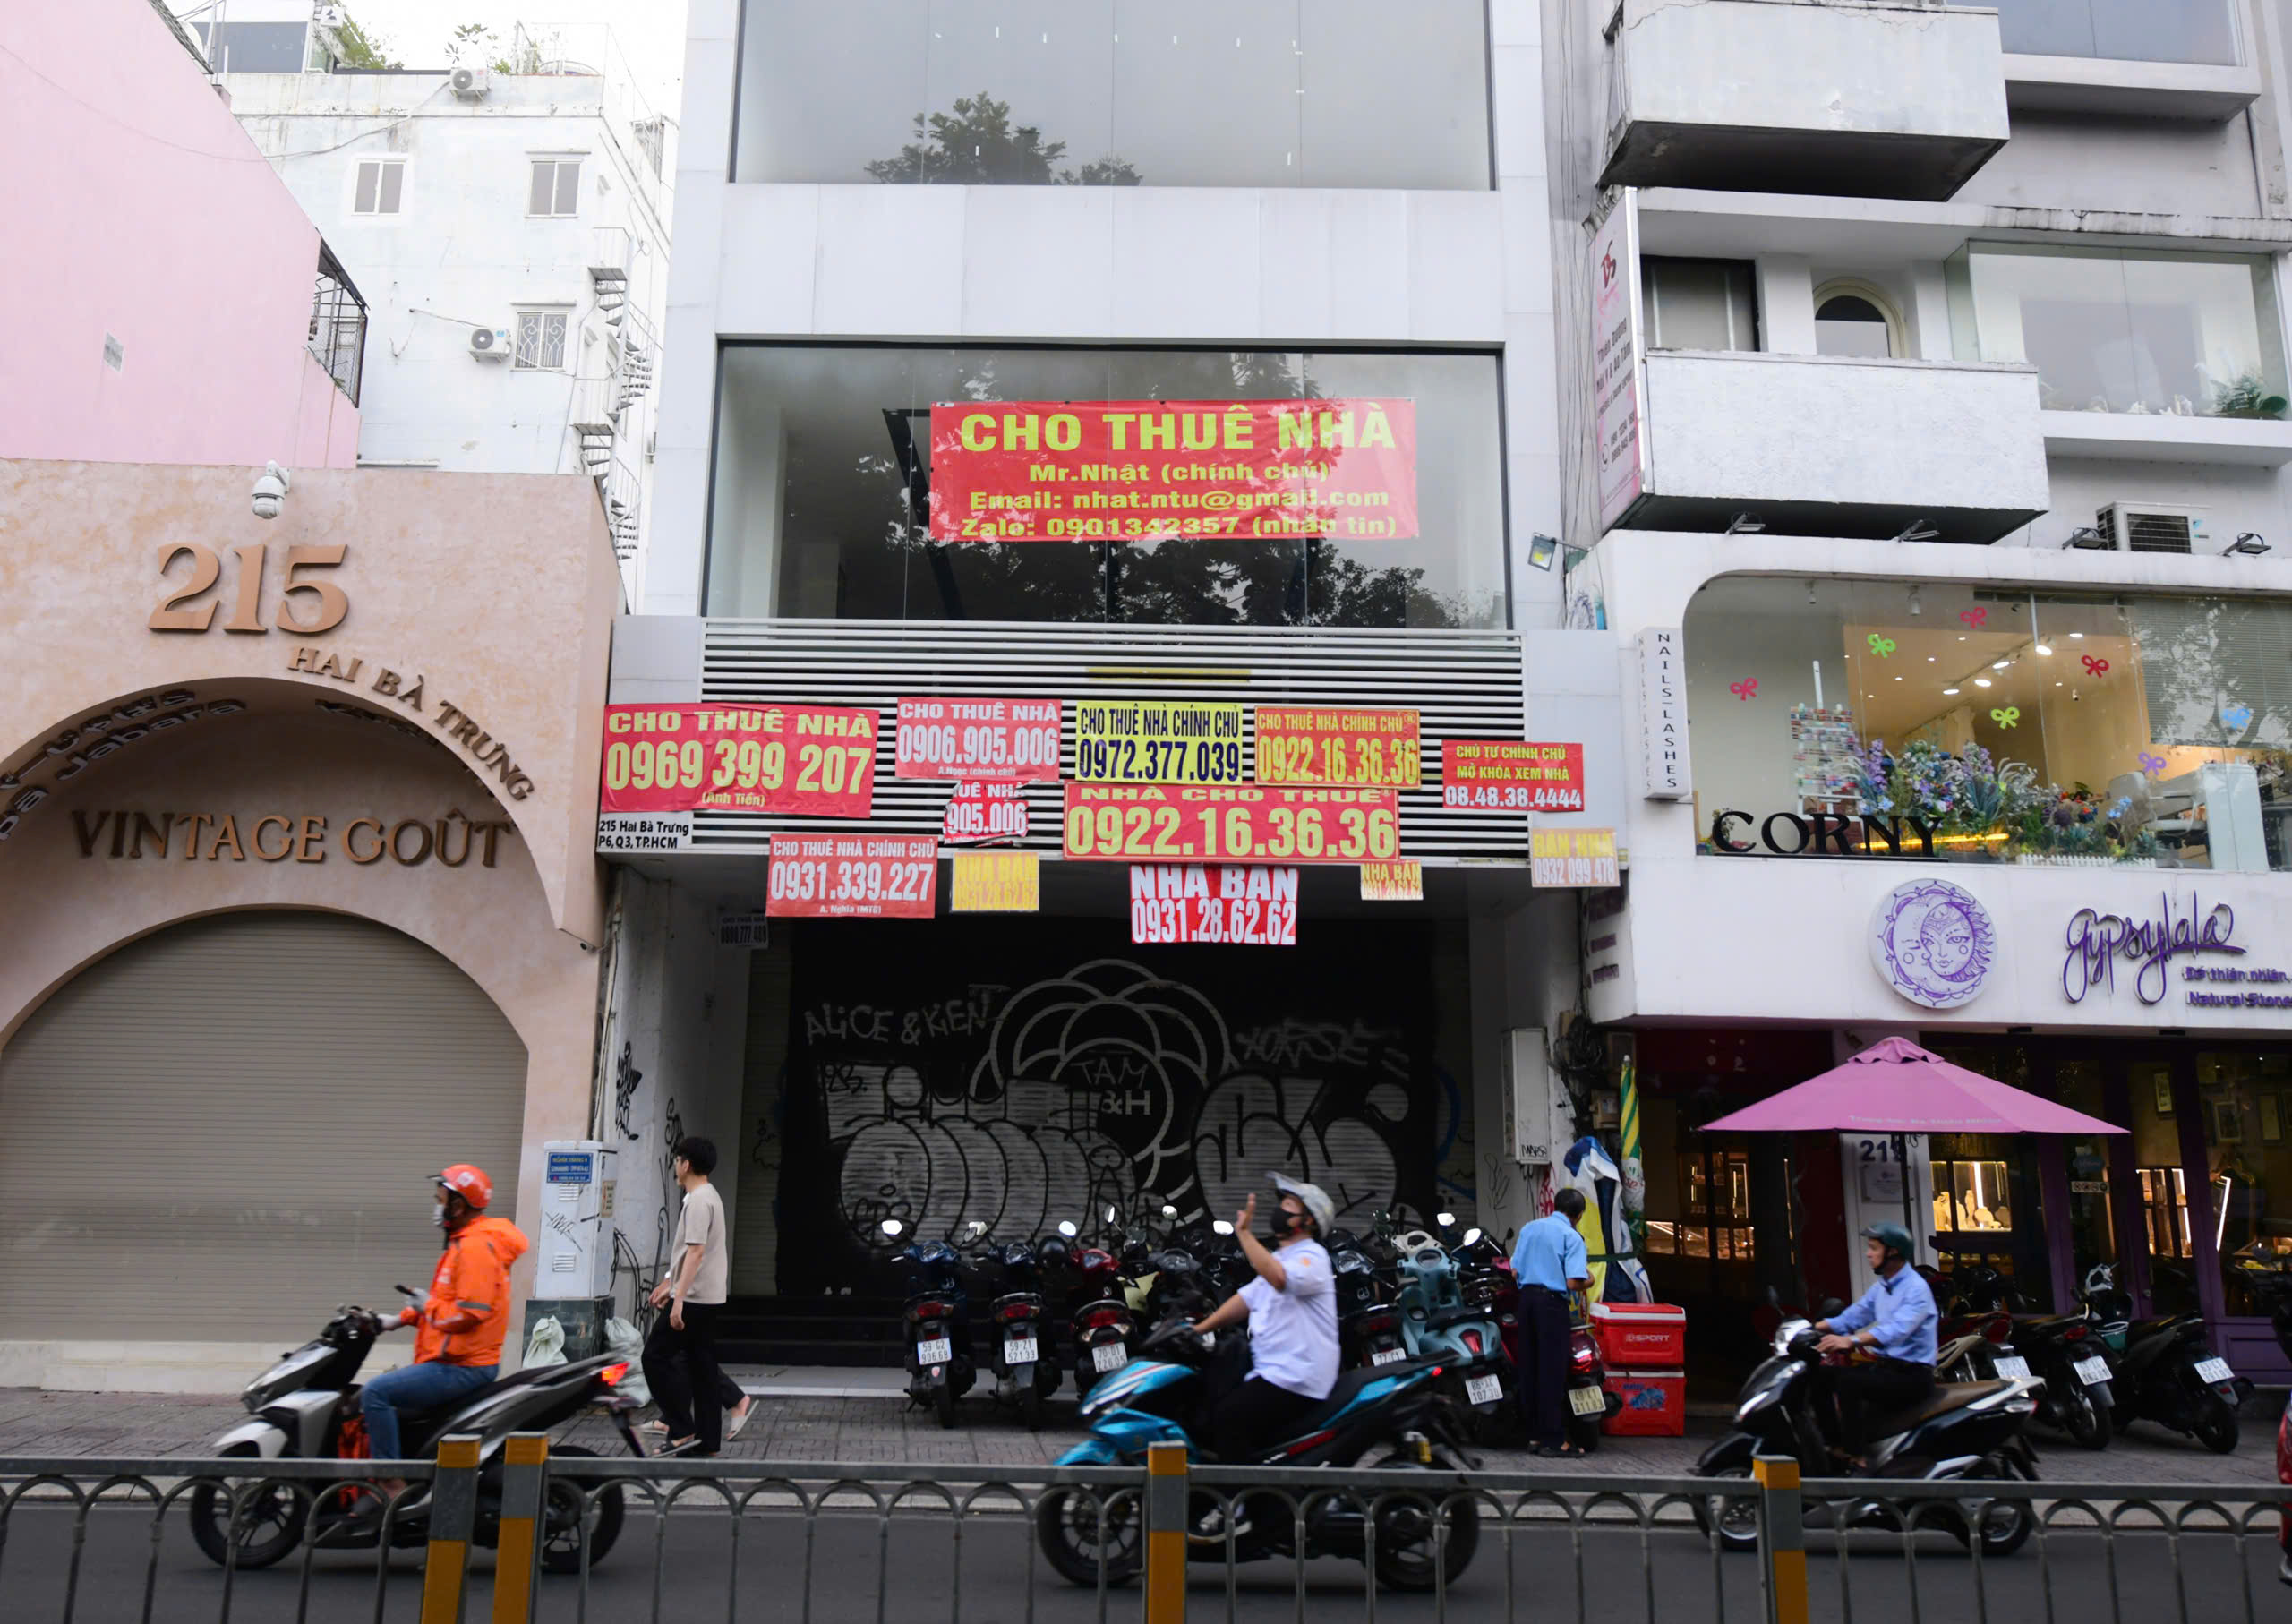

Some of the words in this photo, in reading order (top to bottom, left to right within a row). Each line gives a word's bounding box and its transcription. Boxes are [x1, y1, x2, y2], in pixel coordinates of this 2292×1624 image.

[961, 414, 1082, 451] CHO
[1103, 404, 1254, 450] THUÊ
[1279, 402, 1396, 449] NHÀ
[1030, 464, 1150, 484] Mr.Nhật
[1161, 462, 1253, 484] (chính
[1264, 460, 1329, 483] chủ)
[971, 492, 1062, 509] Email:
[1073, 489, 1389, 511] nhat.ntu@gmail.com
[961, 518, 1035, 537] Zalo:
[1047, 517, 1239, 536] 0901342357
[1253, 512, 1337, 535] (nhắn
[1347, 516, 1397, 535] tin)
[148, 543, 349, 635] 215
[286, 647, 363, 683] HAI
[372, 668, 425, 712] BÀ
[433, 699, 535, 801] TRƯNG
[608, 711, 682, 733] CHO
[694, 709, 784, 733] THUÊ
[796, 713, 873, 739] NHÀ
[900, 703, 944, 718] CHO
[951, 702, 1005, 721] THUÊ
[1013, 703, 1058, 722] NHÀ
[1081, 706, 1105, 735] CHO
[1109, 704, 1138, 736] THUÊ
[1143, 704, 1168, 737] NHÀ
[1173, 705, 1210, 737] CHÍNH
[1215, 705, 1239, 739] CHỦ
[1258, 713, 1280, 731] CHO
[1285, 712, 1313, 731] THUÊ
[1316, 711, 1339, 731] NHÀ
[1342, 712, 1376, 732] CHÍNH
[1380, 712, 1403, 733] CHỦ
[898, 724, 1058, 766] 0906.905.006
[1502, 745, 1538, 760] CHÍNH
[606, 740, 703, 790] 0969
[712, 739, 786, 788] 399
[796, 744, 872, 794] 207
[1079, 739, 1239, 781] 0972.377.039
[1258, 735, 1418, 785] 0922.16.36.36
[1515, 766, 1541, 780] XEM
[954, 782, 981, 798] UÊ
[1081, 786, 1167, 801] NHÀ
[1182, 789, 1264, 802] CHO
[1279, 789, 1380, 804] THUÊ
[1445, 786, 1582, 809] 08.48.38.4444
[71, 809, 328, 865] VINTAGE
[340, 808, 518, 868] GOÛT
[599, 820, 617, 833] 215
[620, 820, 637, 833] Hai
[640, 820, 653, 833] Bà
[656, 821, 688, 836] Trưng
[1068, 806, 1397, 857] 0922.16.36.36
[1712, 811, 1944, 857] CORNY
[774, 841, 799, 857] CHO
[802, 840, 833, 857] THUÊ
[836, 840, 861, 857] NHÀ
[867, 841, 905, 858] CHÍNH
[909, 838, 935, 858] CHỦ
[771, 860, 934, 901] 0931.339.227
[1535, 858, 1565, 885] 0932
[1568, 858, 1591, 885] 099
[1133, 898, 1296, 945] 0931.28.62.62
[2187, 991, 2245, 1006] Natural
